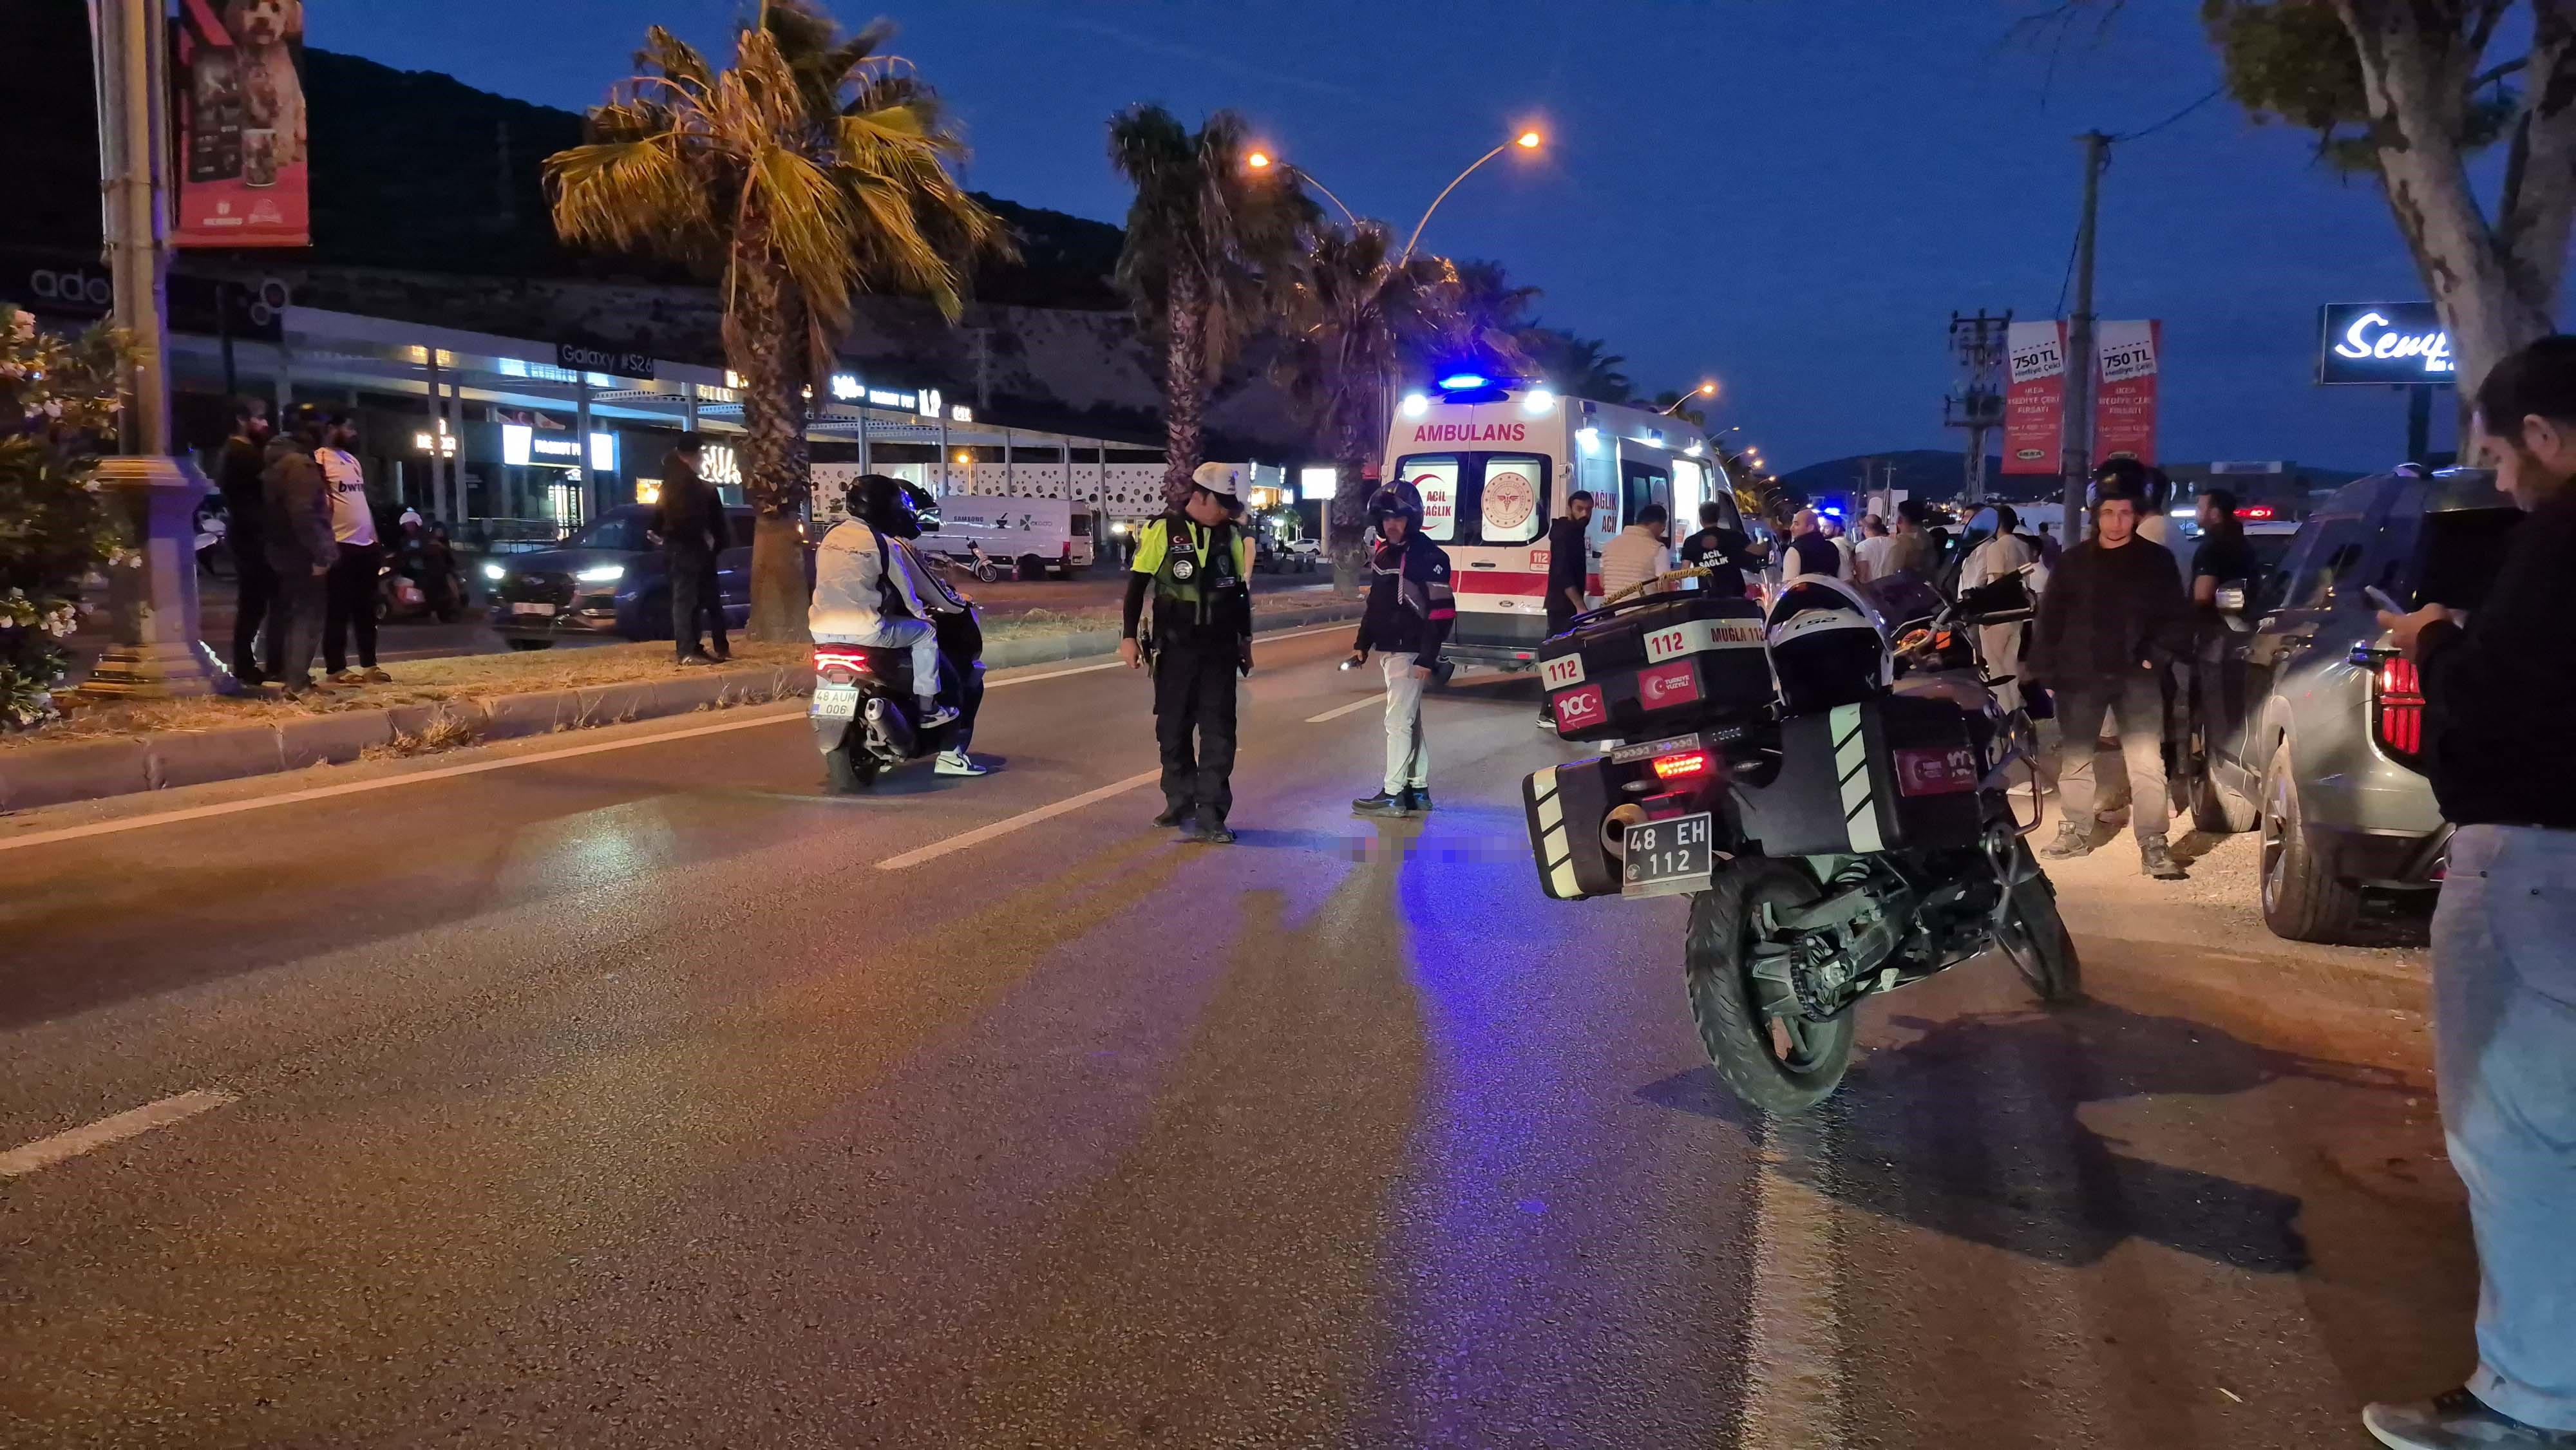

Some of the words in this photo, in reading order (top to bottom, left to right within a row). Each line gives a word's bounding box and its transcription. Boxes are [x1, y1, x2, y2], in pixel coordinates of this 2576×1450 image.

[31, 268, 109, 305] ado
[2334, 312, 2450, 370] Semp
[562, 344, 614, 373] Galaxy
[621, 353, 653, 373] #S26
[2013, 353, 2039, 370] 750
[2040, 350, 2059, 362] TL
[2103, 352, 2130, 368] 750
[2132, 349, 2152, 362] TL
[1414, 424, 1526, 442] AMBULANS
[339, 480, 363, 493] bwi
[1426, 489, 1446, 502] ACİL
[1533, 552, 1549, 563] 112
[1794, 617, 1838, 630] LS2
[1652, 632, 1684, 655] 112
[1710, 625, 1747, 643] MUĞLA
[1548, 660, 1577, 682] 112
[817, 691, 829, 701] 48
[832, 692, 856, 702] AUM
[826, 704, 848, 715] 006
[1630, 829, 1656, 852] 48
[1677, 820, 1705, 845] EH
[1650, 849, 1690, 875] 112
